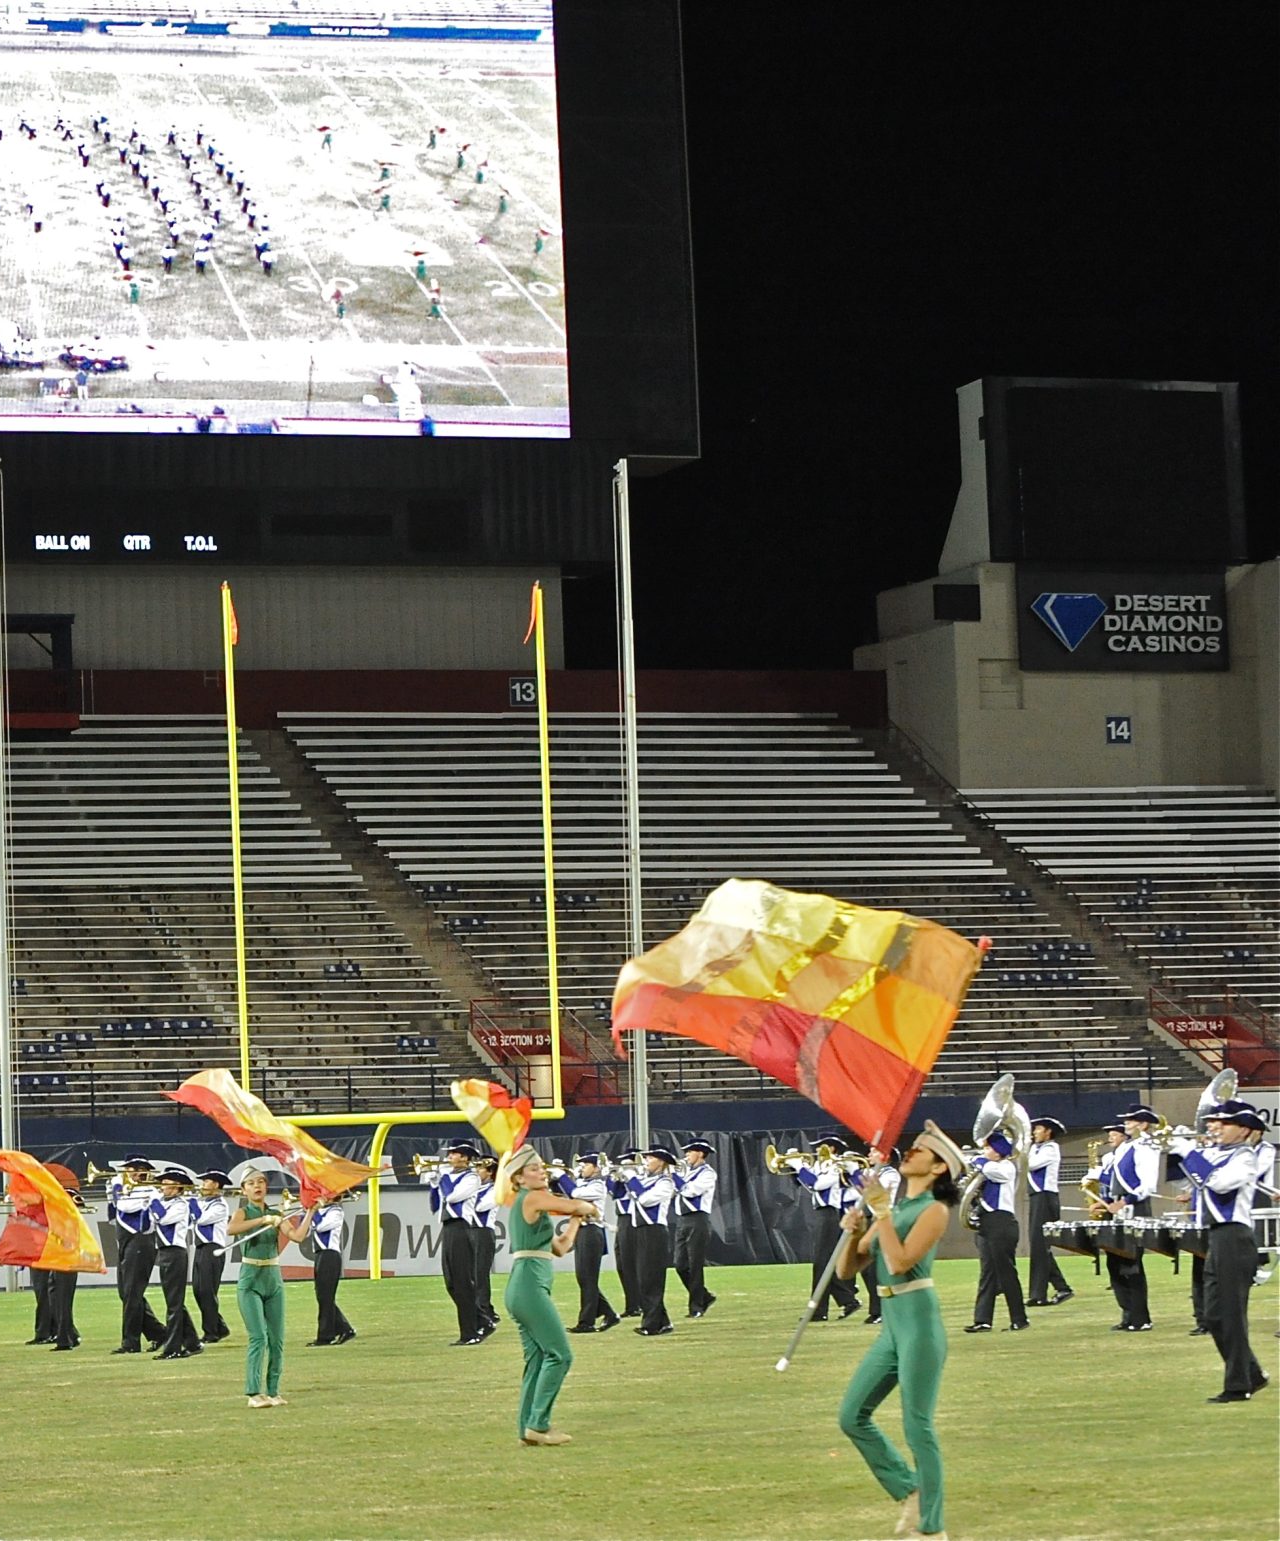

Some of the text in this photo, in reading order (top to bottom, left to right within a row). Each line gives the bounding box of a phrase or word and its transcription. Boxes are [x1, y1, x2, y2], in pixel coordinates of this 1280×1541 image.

[35, 535, 90, 550] BALL ON
[123, 535, 151, 550] QTR
[184, 535, 217, 551] T.O.L
[1114, 594, 1211, 612] DESERT
[1104, 614, 1223, 632] DIAMOND
[1107, 635, 1221, 653] CASINOS
[511, 682, 536, 702] 13
[1107, 720, 1130, 740] 14
[500, 1034, 533, 1047] SECTION
[535, 1034, 544, 1046] 13
